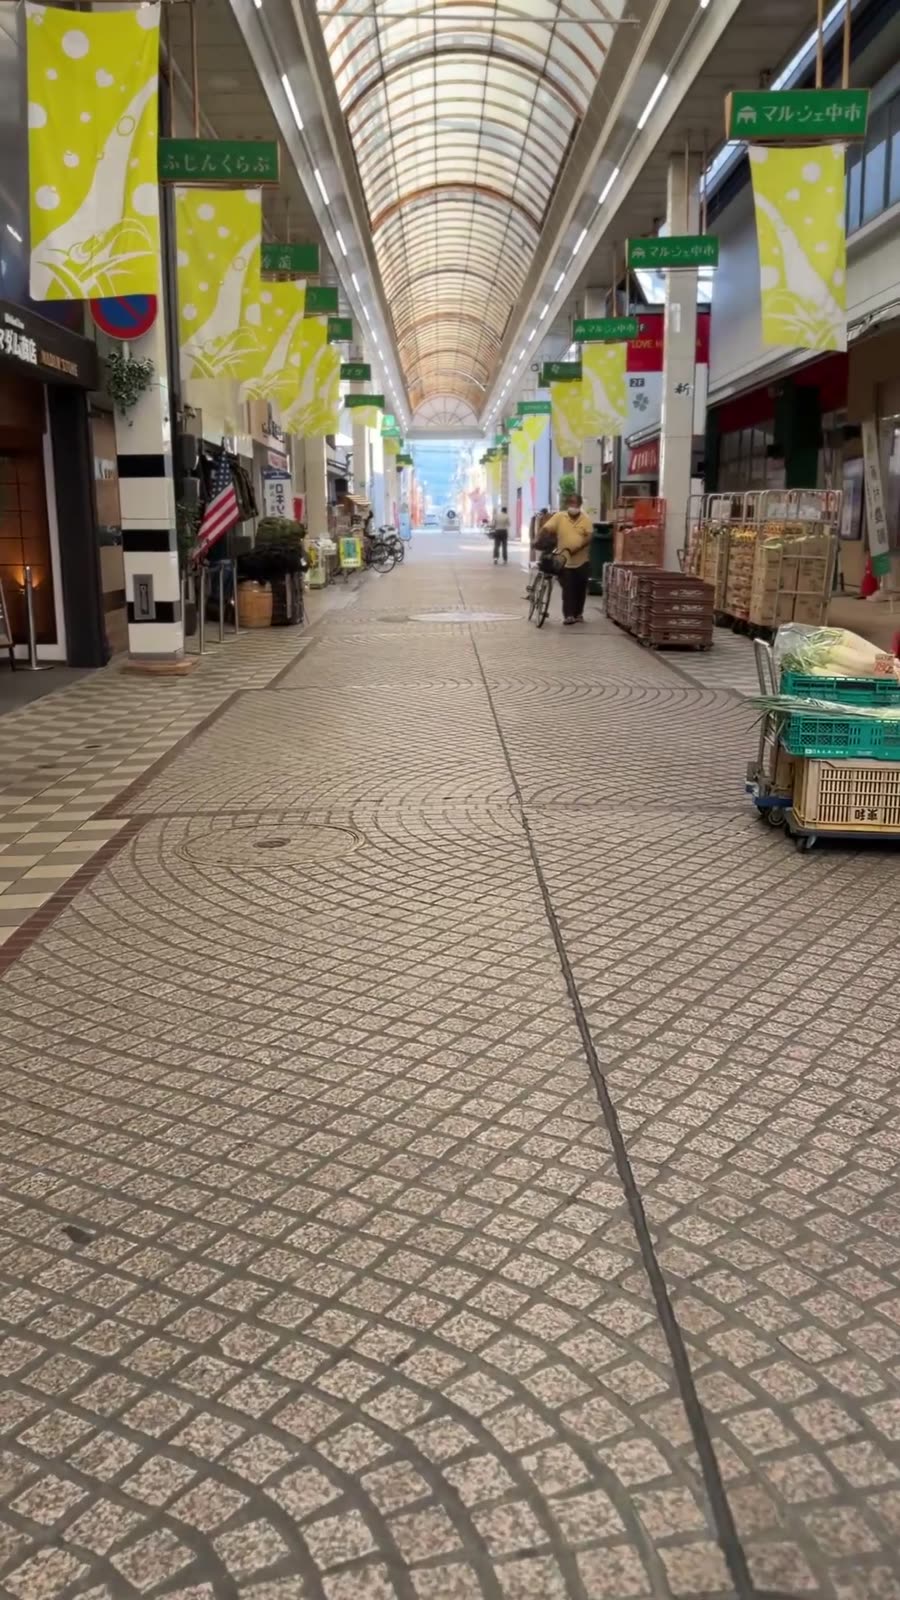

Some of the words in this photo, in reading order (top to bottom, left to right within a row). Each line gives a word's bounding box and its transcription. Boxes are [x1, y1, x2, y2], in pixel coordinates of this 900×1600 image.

[163, 153, 270, 173] ふじんくらぶ
[631, 379, 645, 387] 2F
